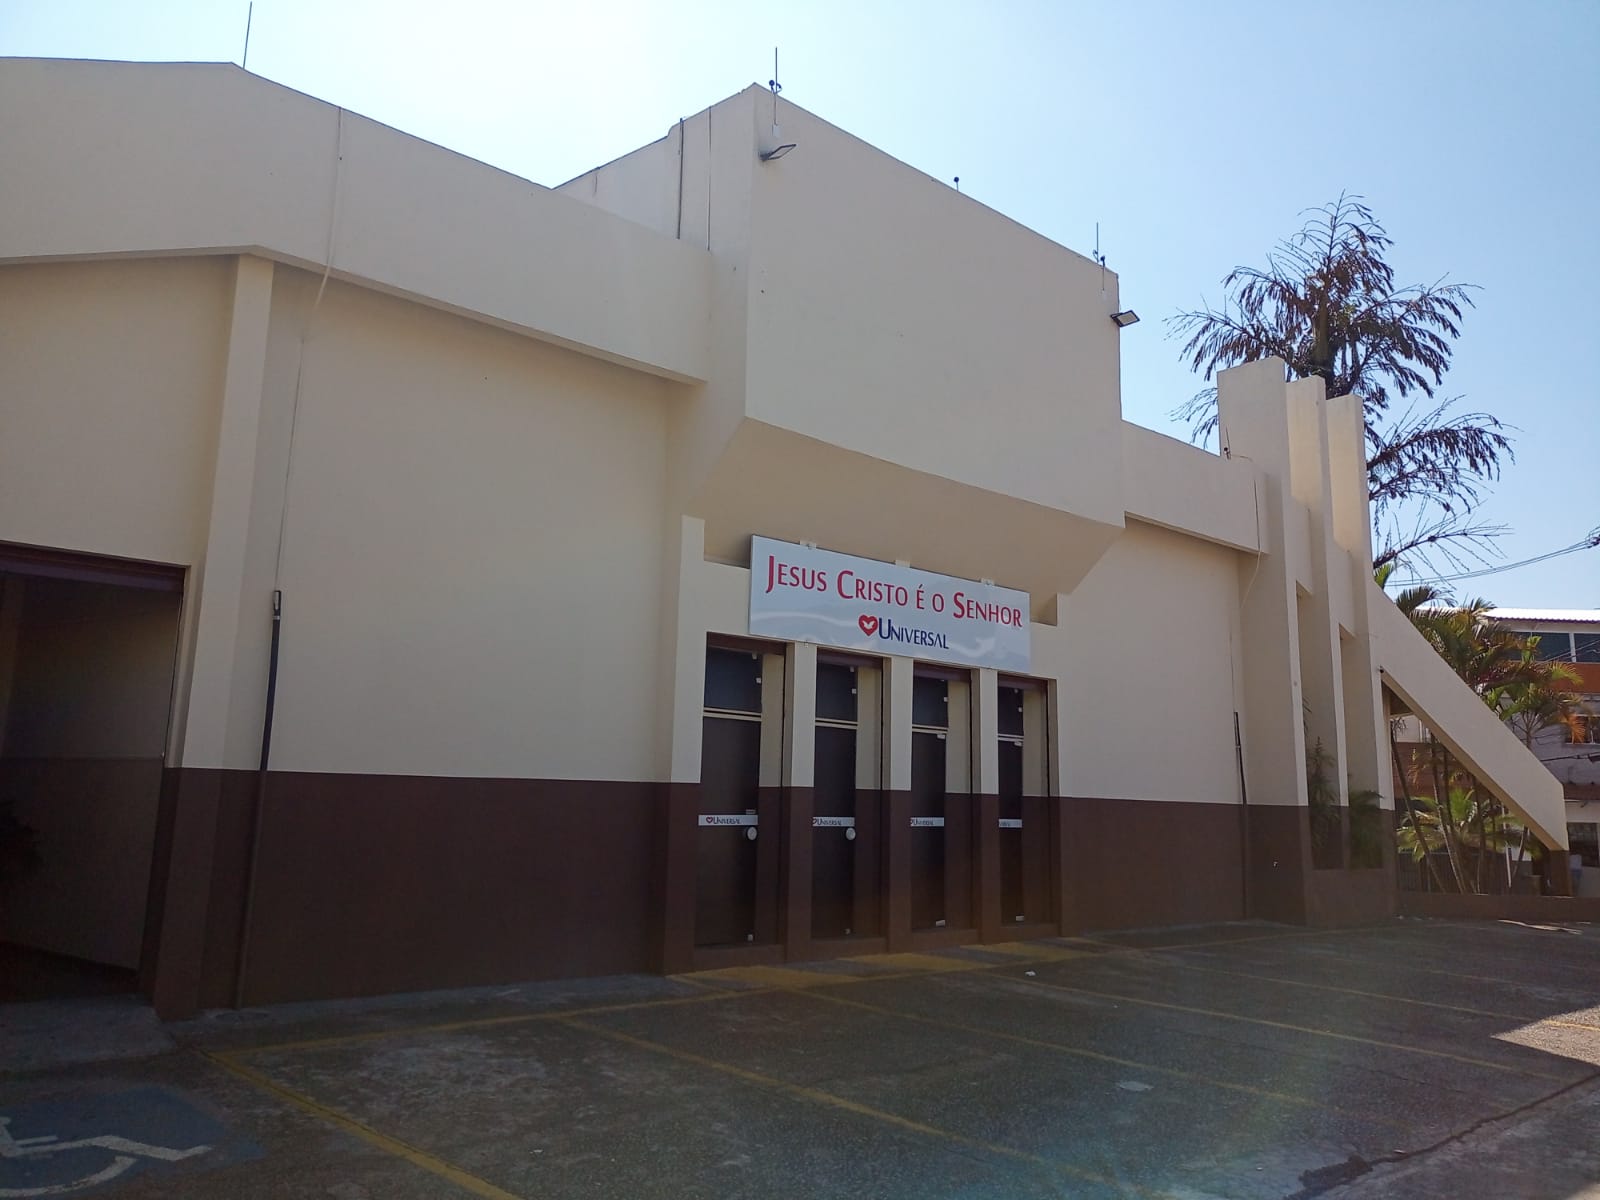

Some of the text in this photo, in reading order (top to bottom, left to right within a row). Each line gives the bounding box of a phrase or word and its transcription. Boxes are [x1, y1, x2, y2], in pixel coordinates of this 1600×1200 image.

[765, 555, 1023, 628] JESUS CRISTO É O SENHOR
[878, 617, 950, 650] UNIVERSAL
